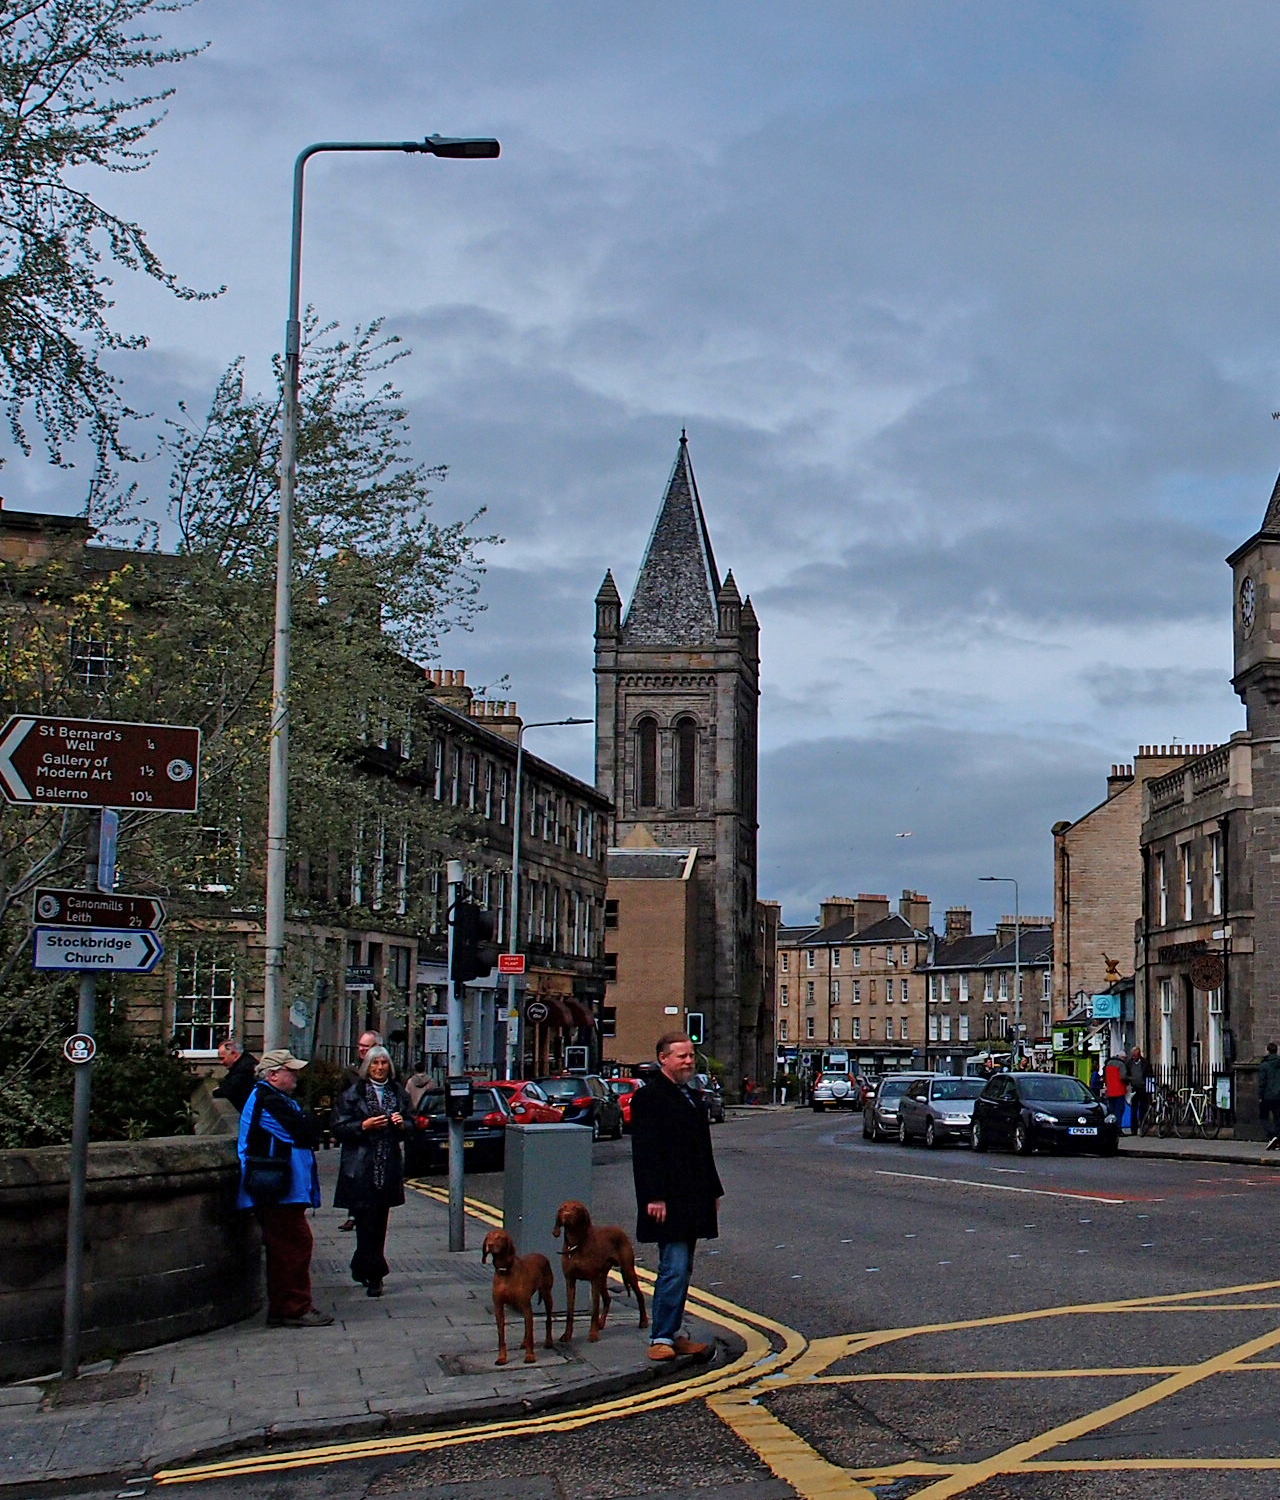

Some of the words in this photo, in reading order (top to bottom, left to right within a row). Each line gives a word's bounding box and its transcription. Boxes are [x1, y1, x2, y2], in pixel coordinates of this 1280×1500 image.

[39, 725, 55, 737] St
[59, 727, 122, 741] Bernard's
[66, 739, 95, 751] Well
[42, 753, 91, 768] Gallery
[94, 756, 109, 767] of
[36, 766, 88, 779] Modern
[91, 769, 112, 781] Art
[35, 786, 89, 799] Balerno
[67, 897, 124, 911] Canonmills
[66, 911, 92, 923] Leith
[46, 936, 132, 950] Stockbridge
[64, 952, 114, 963] Church
